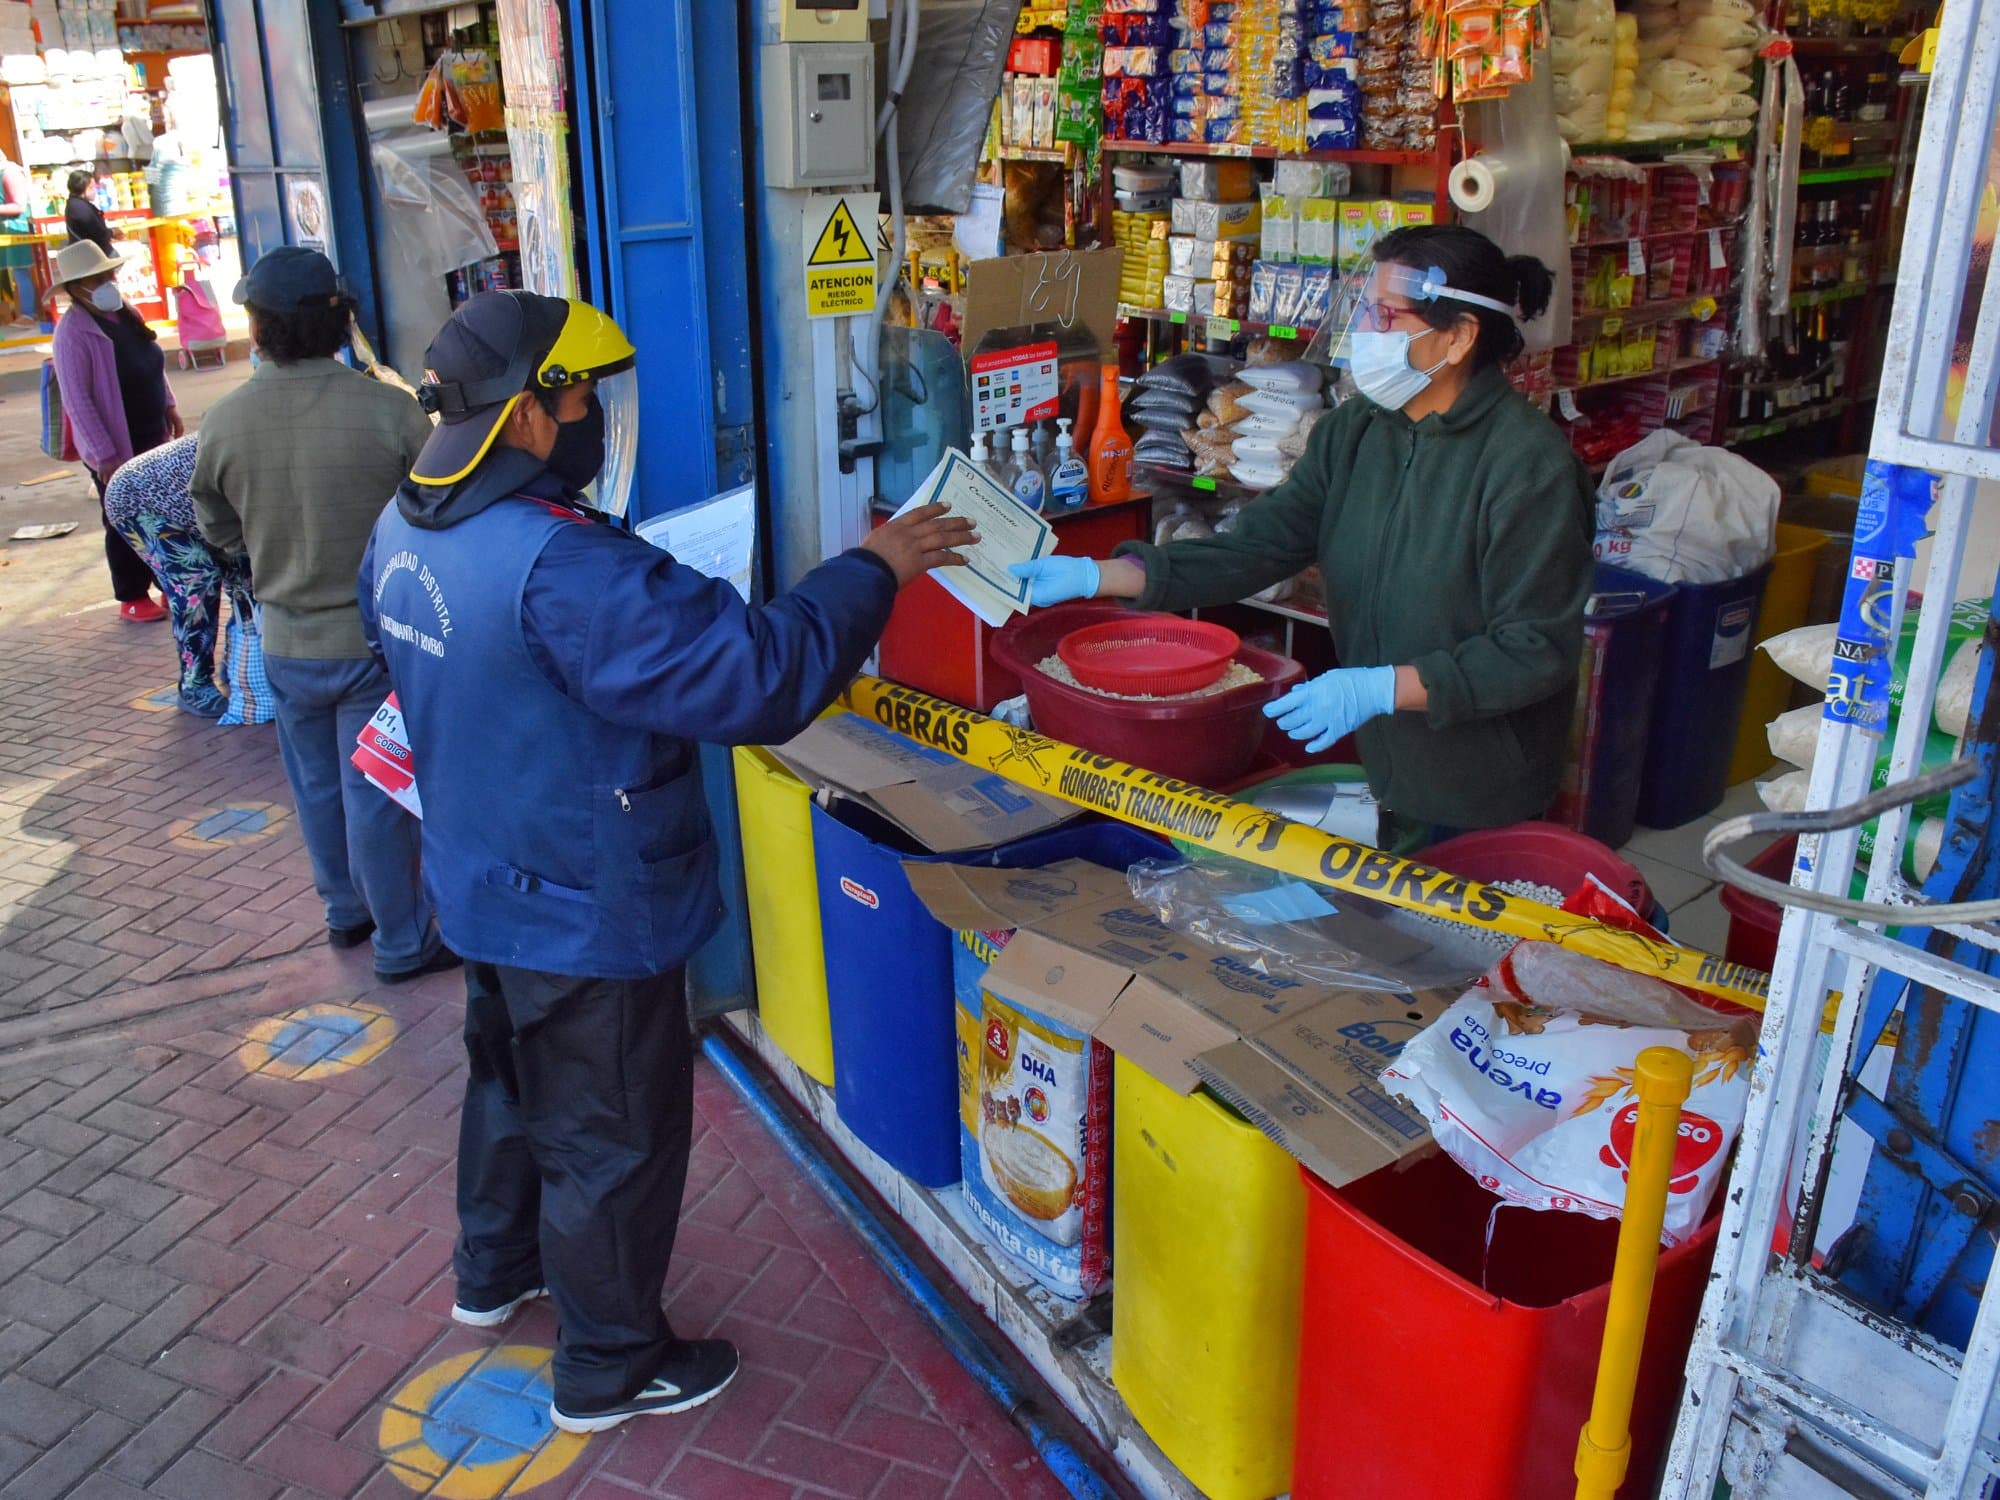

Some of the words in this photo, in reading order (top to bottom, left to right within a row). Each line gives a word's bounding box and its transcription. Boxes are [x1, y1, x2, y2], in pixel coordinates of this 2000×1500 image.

[811, 273, 873, 290] ATENCIÓN
[821, 298, 873, 308] ELÉCTRICO
[828, 290, 856, 299] RIESGO
[968, 485, 1018, 529] Certificado
[418, 563, 455, 638] DISTRITAL
[420, 632, 445, 658] RIVERO
[875, 695, 970, 756] OBRAS
[1058, 764, 1125, 812] HOMBRES
[1124, 785, 1223, 842] TRABAJANDO
[1319, 842, 1515, 922] OBRAS
[1021, 1053, 1056, 1087] DHA
[1449, 1027, 1562, 1110] avena
